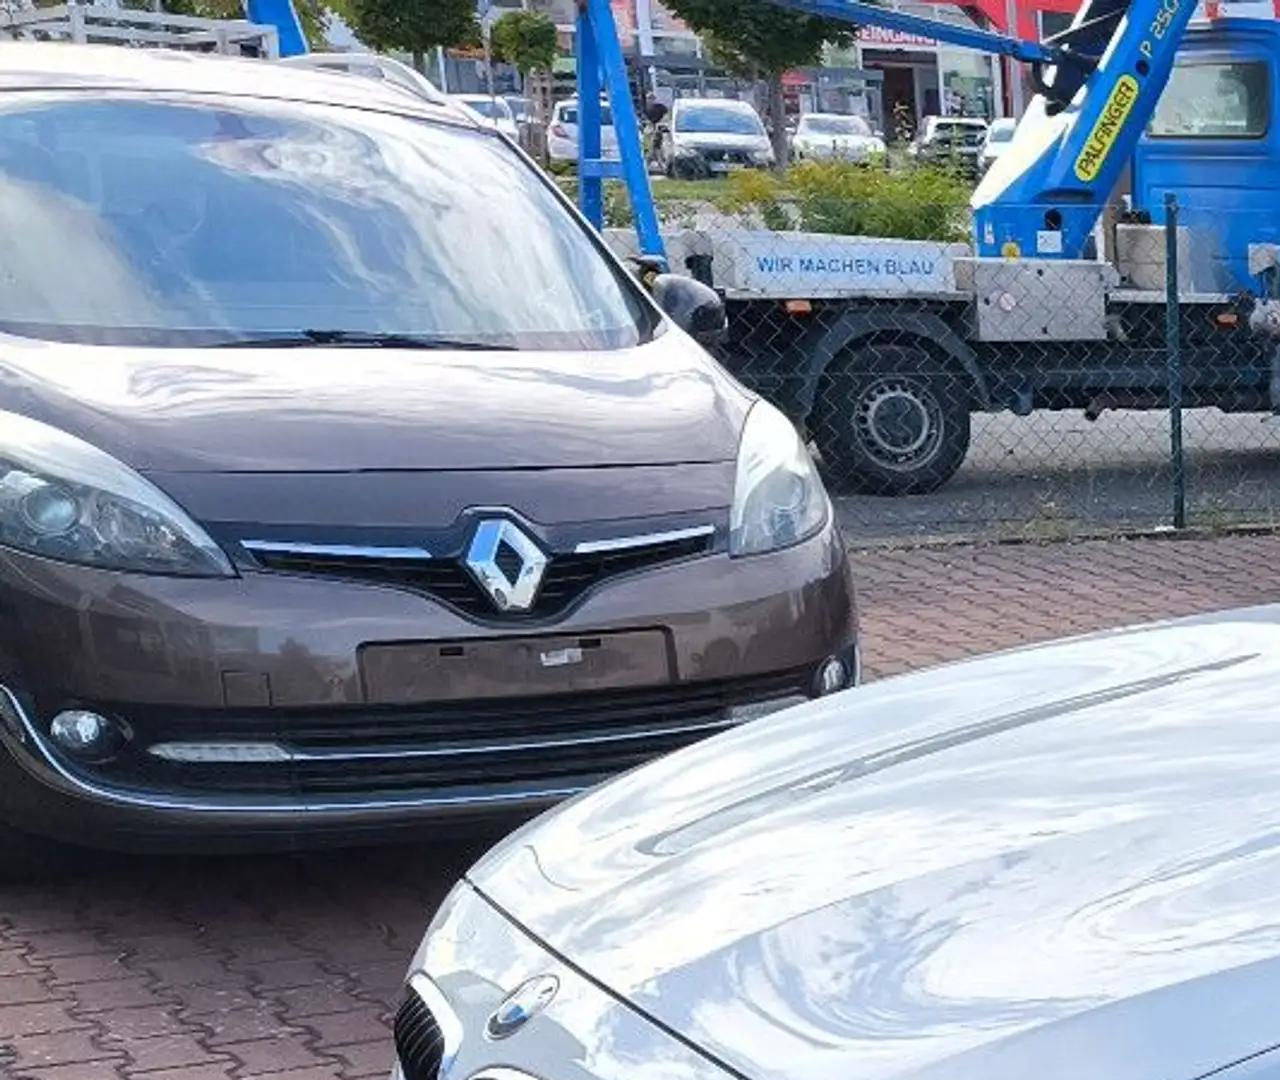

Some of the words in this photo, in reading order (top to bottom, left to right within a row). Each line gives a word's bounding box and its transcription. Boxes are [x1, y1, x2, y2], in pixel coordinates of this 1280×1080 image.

[1140, 40, 1152, 58] P
[1078, 81, 1135, 176] PALFINGER
[756, 256, 793, 273] WIR
[799, 257, 880, 274] MACHEN
[883, 258, 935, 275] BLAU
